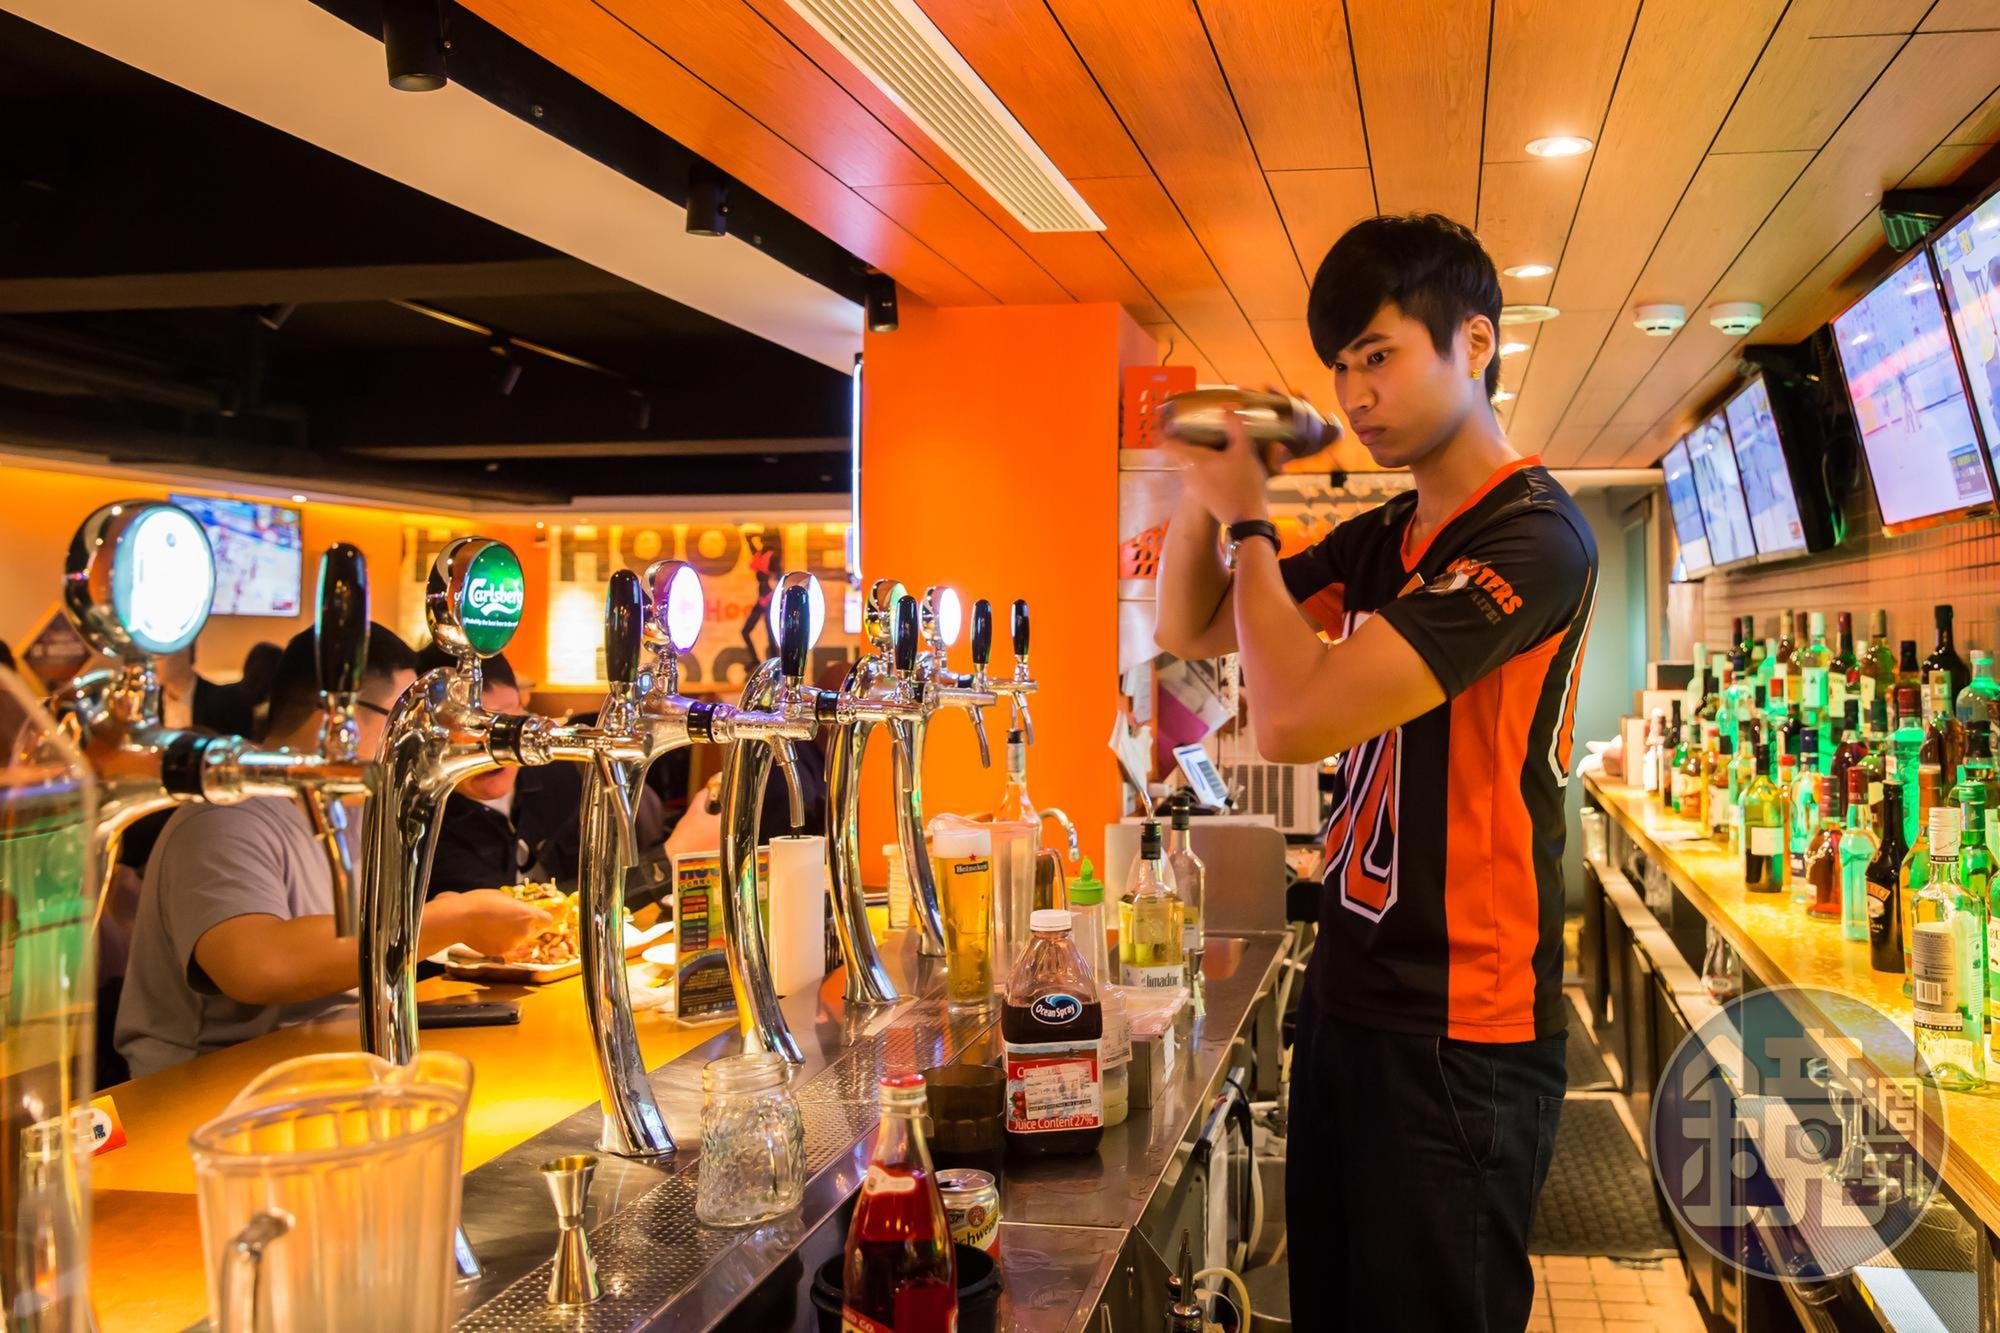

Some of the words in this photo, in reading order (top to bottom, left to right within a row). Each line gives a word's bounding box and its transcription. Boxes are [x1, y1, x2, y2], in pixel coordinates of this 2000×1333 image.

[1035, 1004, 1056, 1017] Ocean
[1056, 1004, 1075, 1019] Spray
[1014, 1118, 1037, 1130] Juice
[1038, 1116, 1074, 1129] Content
[1075, 1115, 1094, 1128] 27%
